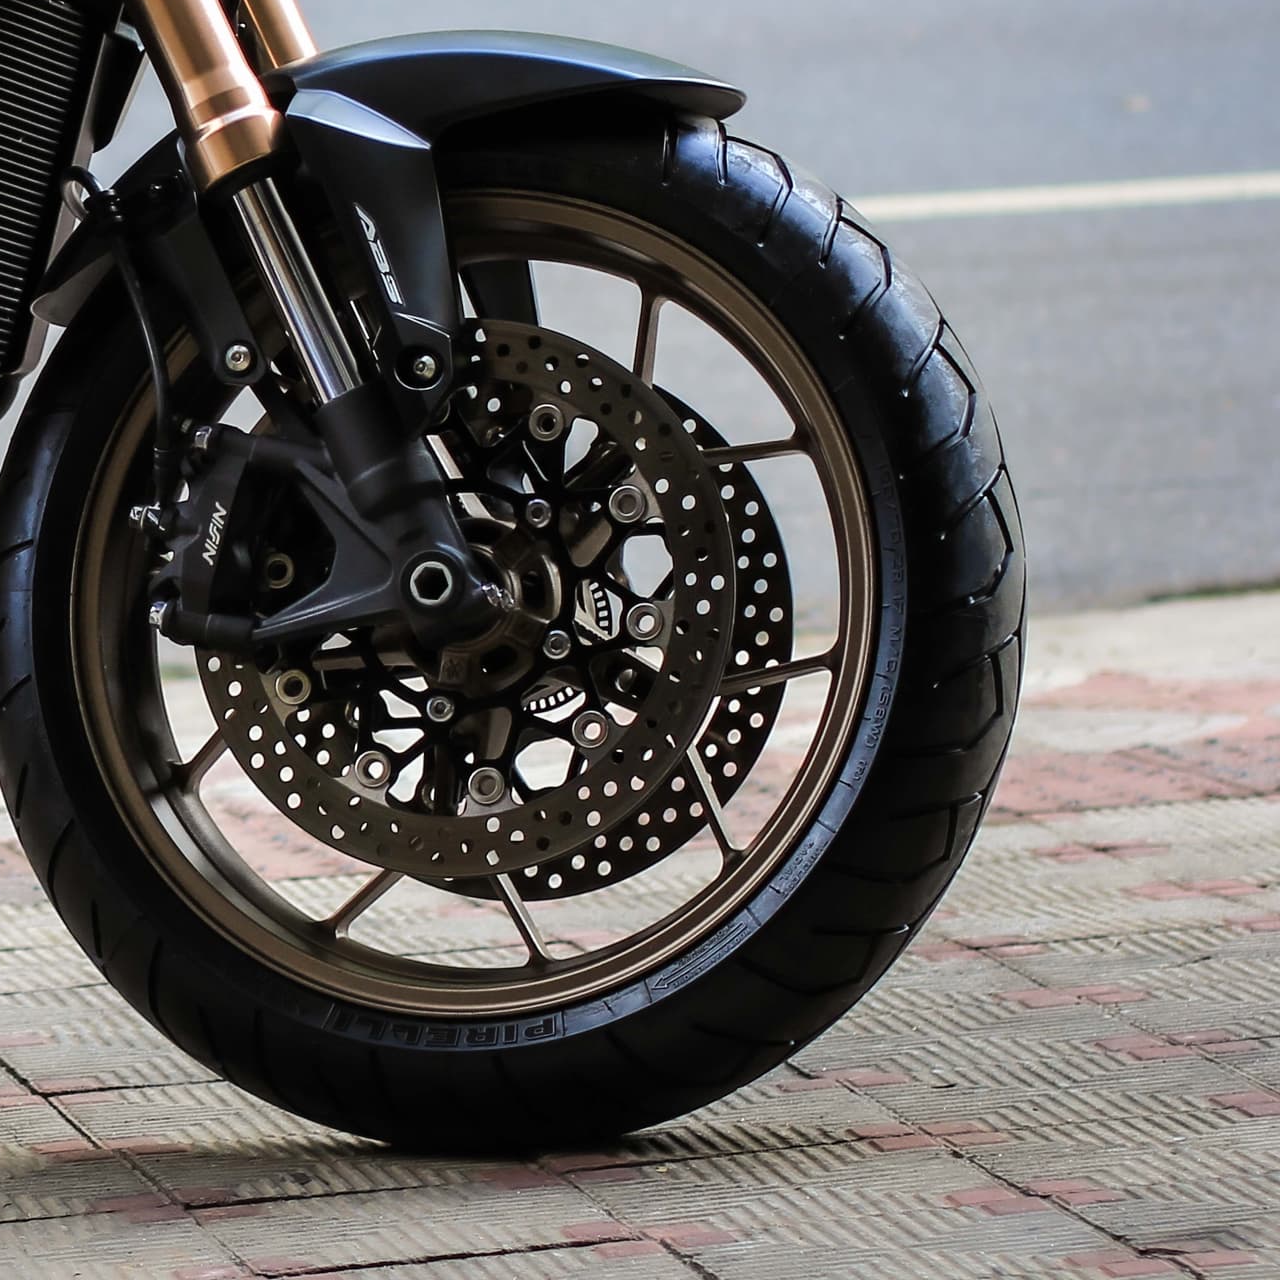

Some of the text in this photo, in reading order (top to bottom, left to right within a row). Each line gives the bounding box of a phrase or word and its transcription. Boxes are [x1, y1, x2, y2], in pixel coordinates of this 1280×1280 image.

[353, 203, 406, 308] ABS
[202, 501, 227, 566] NISSIN
[332, 1010, 558, 1048] PIRELLI
